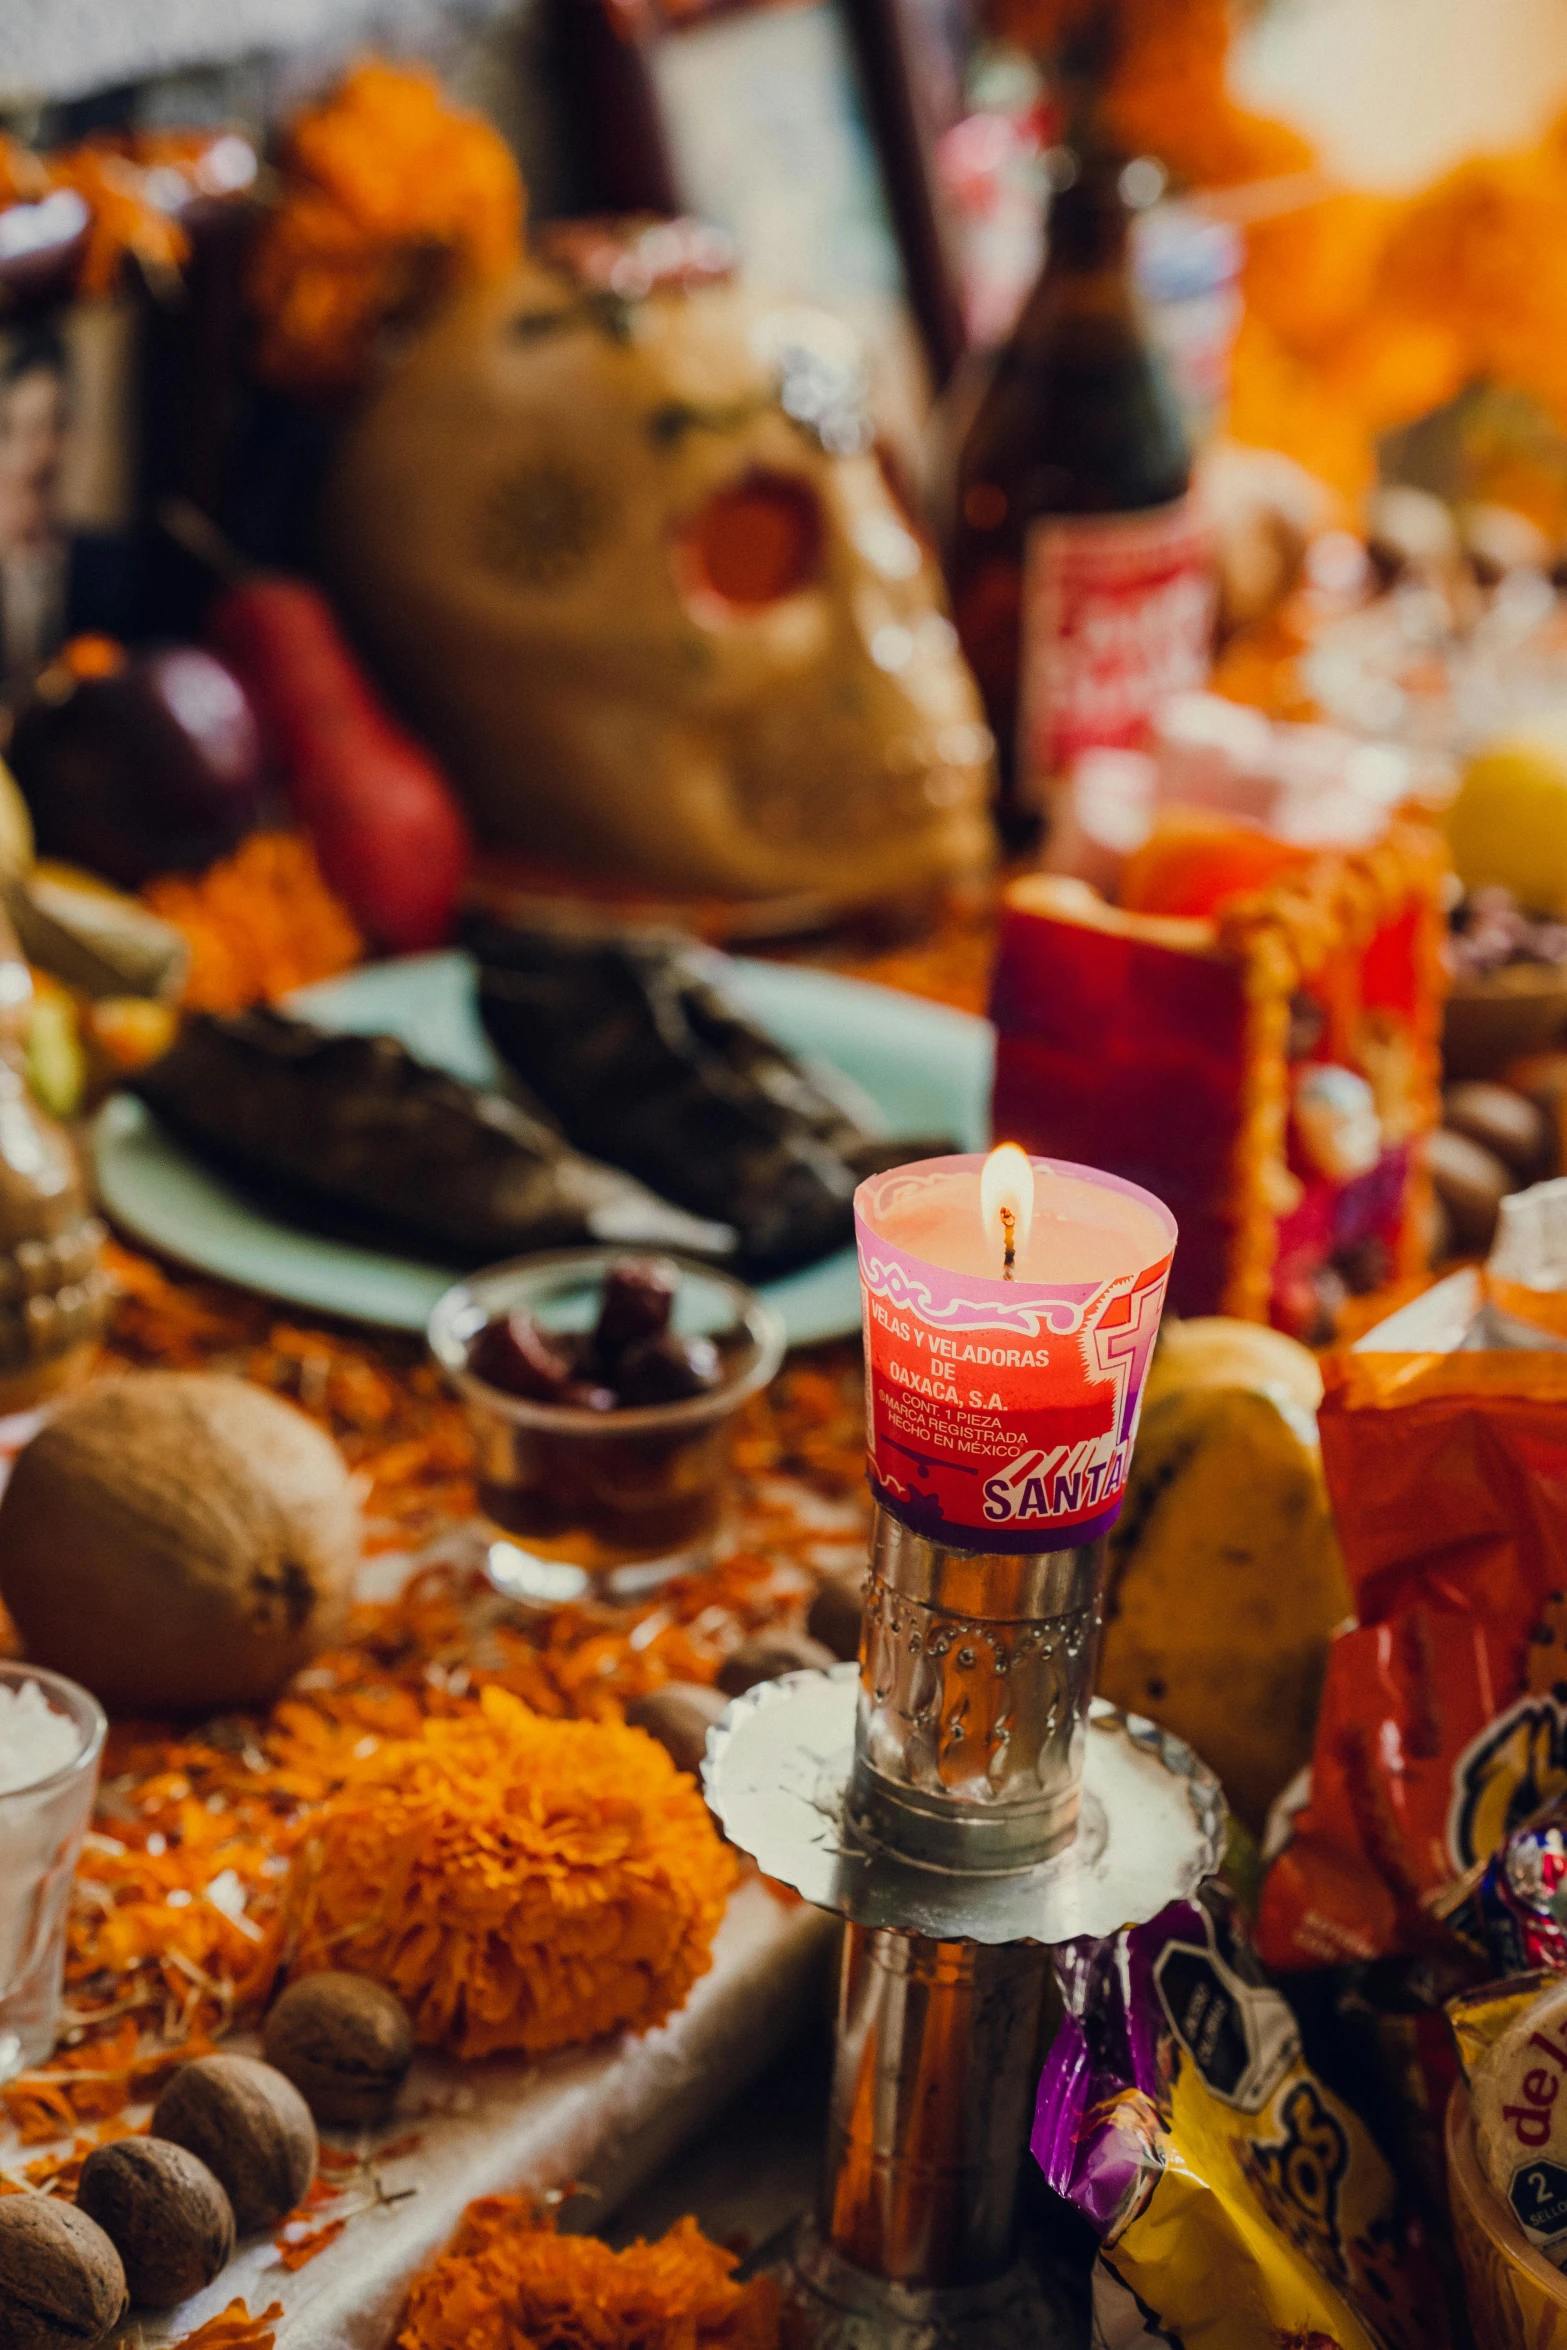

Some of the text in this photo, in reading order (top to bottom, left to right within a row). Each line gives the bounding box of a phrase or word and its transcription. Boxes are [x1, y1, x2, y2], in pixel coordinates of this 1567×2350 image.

[872, 1299, 1050, 1368] VELAS Y VELADORAS
[890, 1361, 1008, 1412] OAXACA, S.A.
[931, 1358, 956, 1382] DE
[902, 1392, 1002, 1429] CONT. 1 PIEZA
[928, 1417, 1029, 1444] REGISTRADA
[888, 1410, 1021, 1458] HECHO EN MÉXICO
[983, 1452, 1125, 1523] SANTA
[1527, 2171, 1554, 2204] 2
